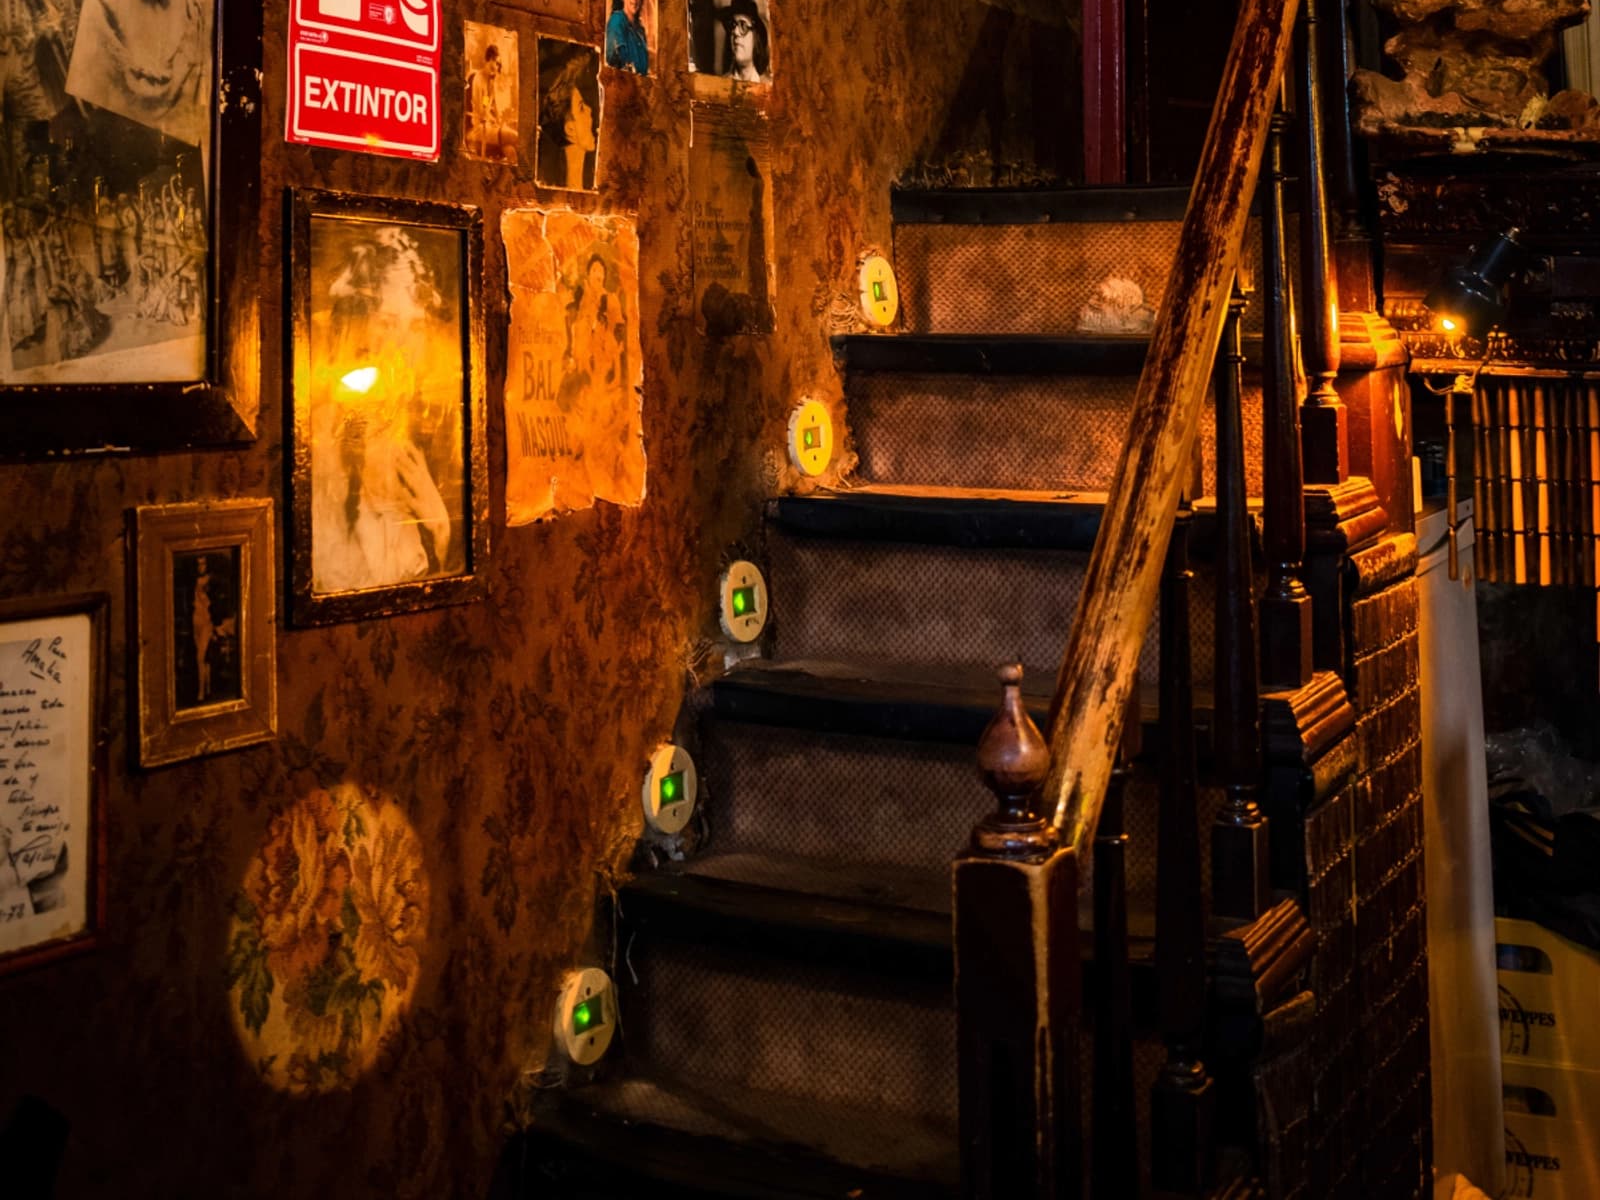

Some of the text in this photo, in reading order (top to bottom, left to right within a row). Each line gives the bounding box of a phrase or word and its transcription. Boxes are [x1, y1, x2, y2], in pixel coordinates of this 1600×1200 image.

[304, 75, 427, 125] EXTINTOR
[522, 351, 556, 401] BAL
[1499, 1007, 1557, 1028] WEPPES
[1505, 1150, 1561, 1171] WEPPES
